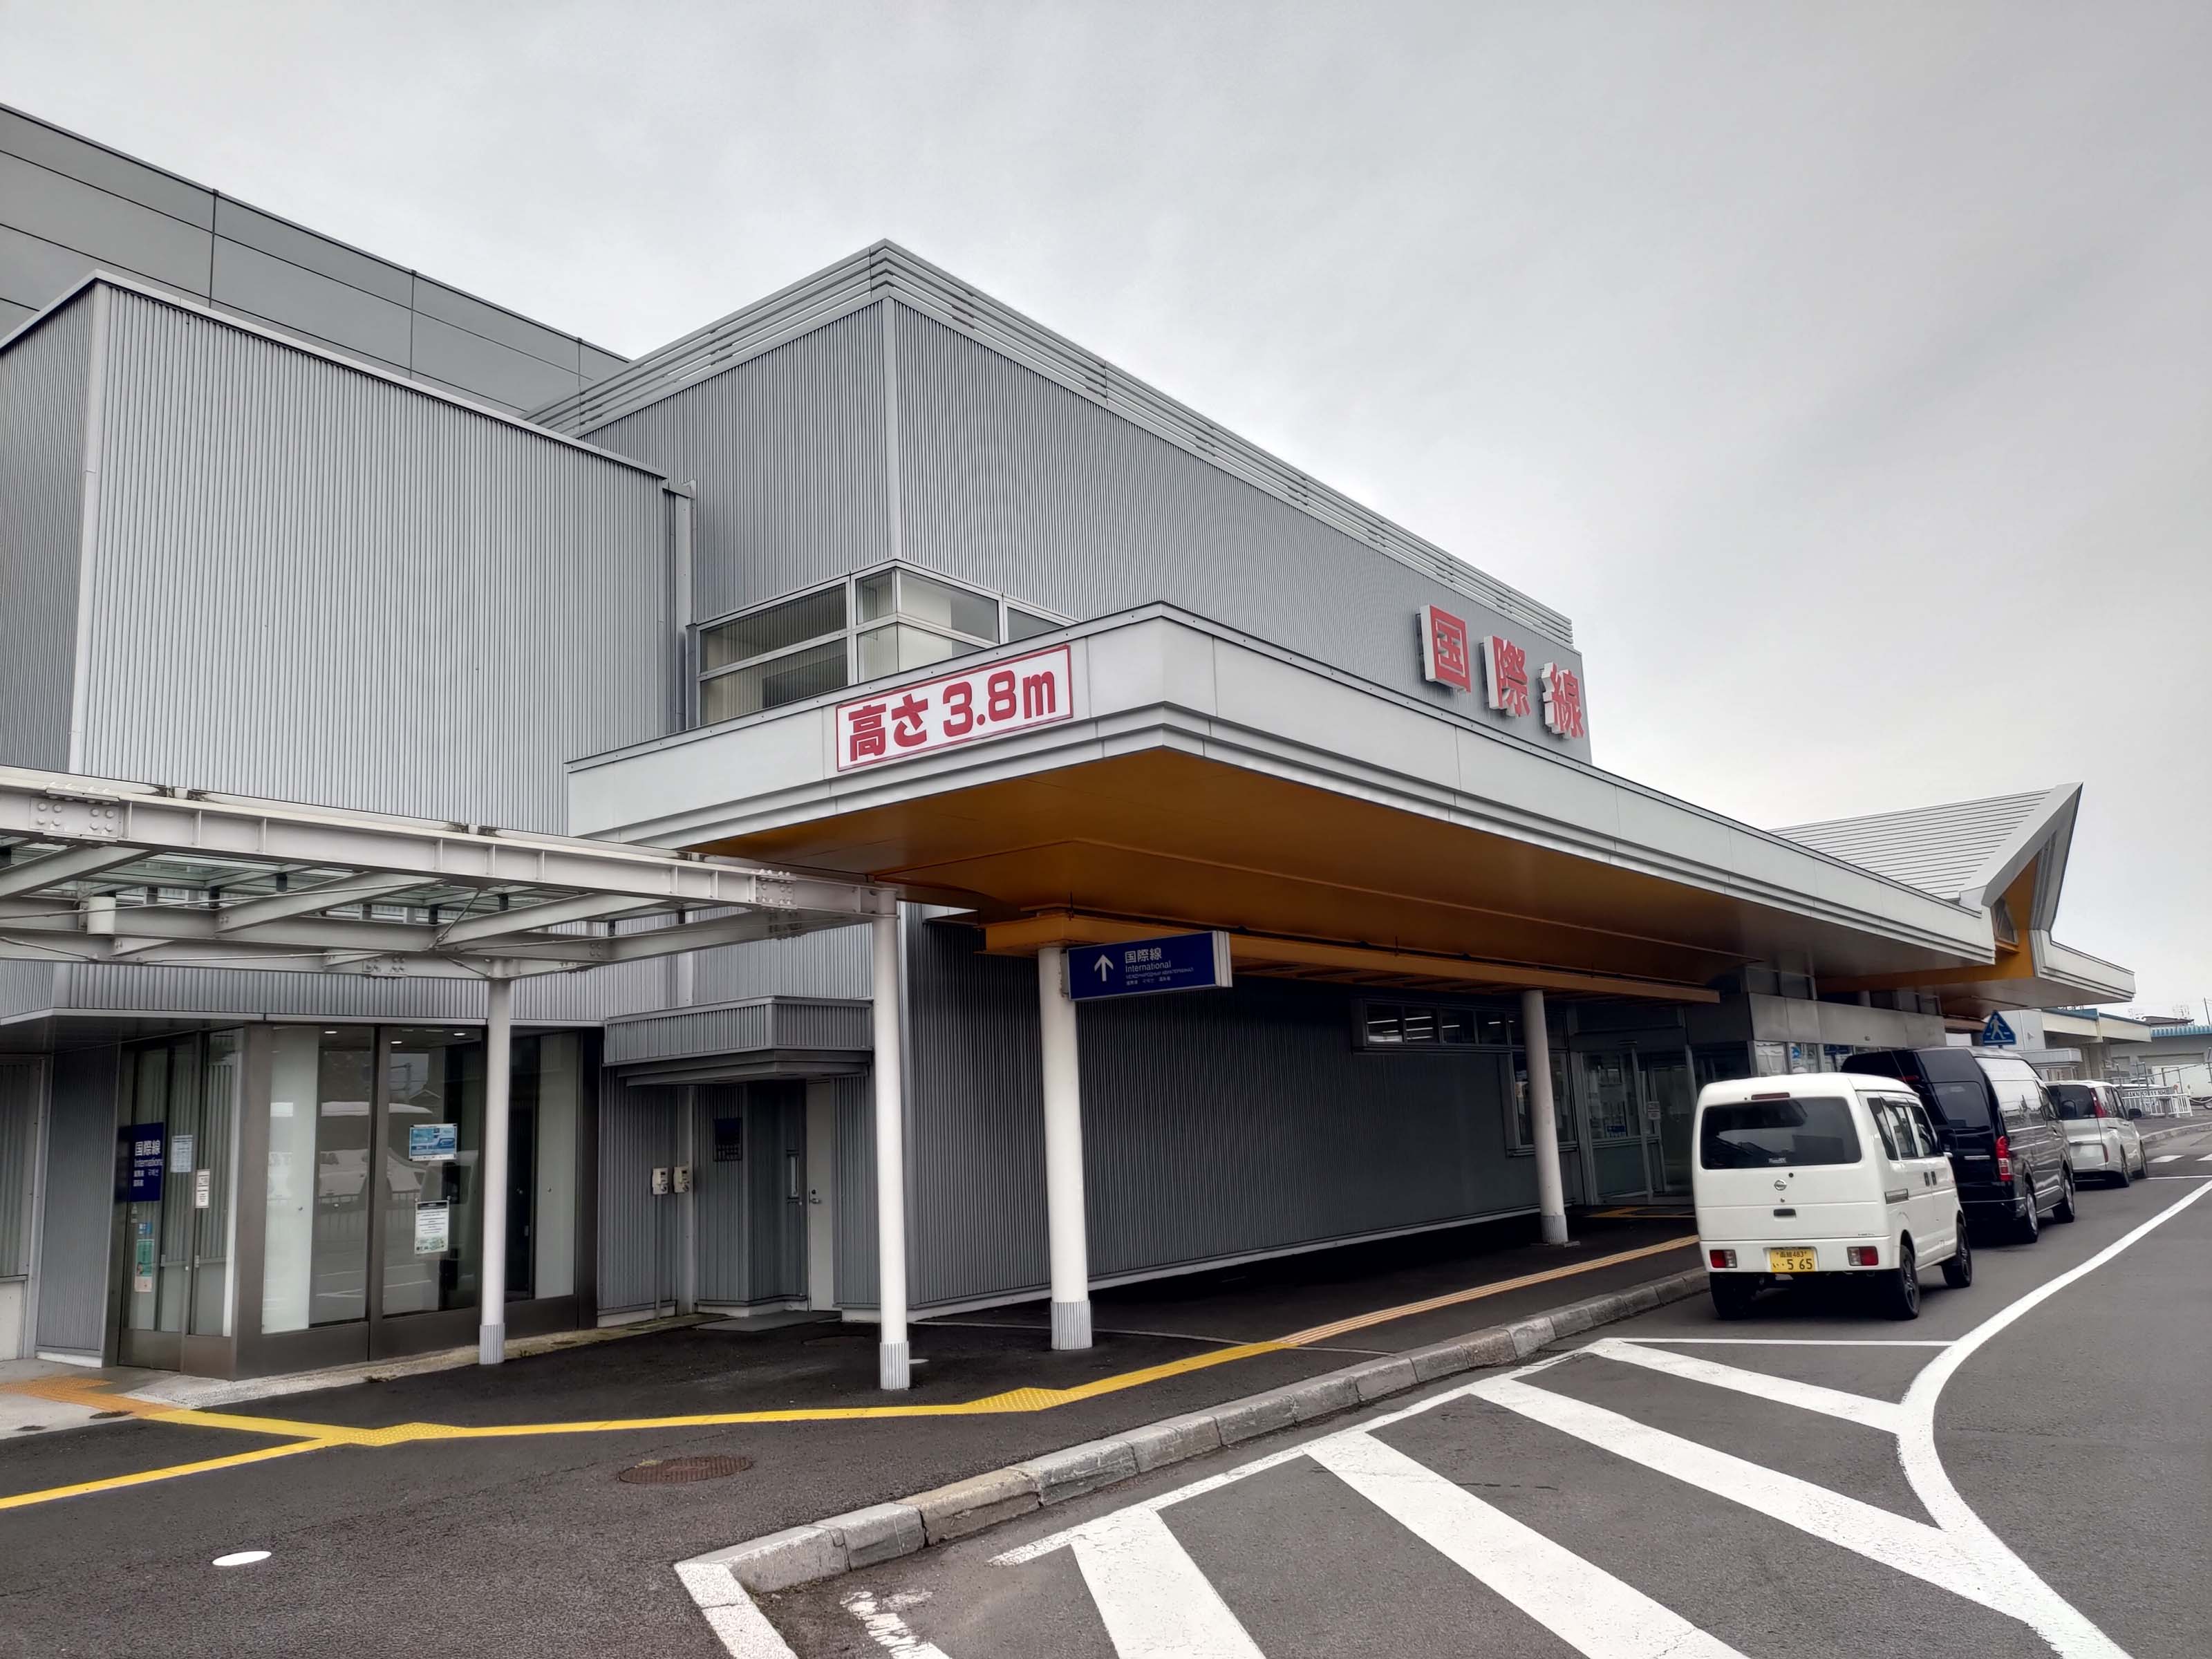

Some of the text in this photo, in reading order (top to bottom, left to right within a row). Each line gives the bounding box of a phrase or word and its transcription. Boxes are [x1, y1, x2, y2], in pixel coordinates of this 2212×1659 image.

[1421, 604, 1584, 738] 国際線
[1125, 948, 1161, 963] 国際線
[1125, 959, 1171, 973] International
[135, 1139, 161, 1156] 国際線
